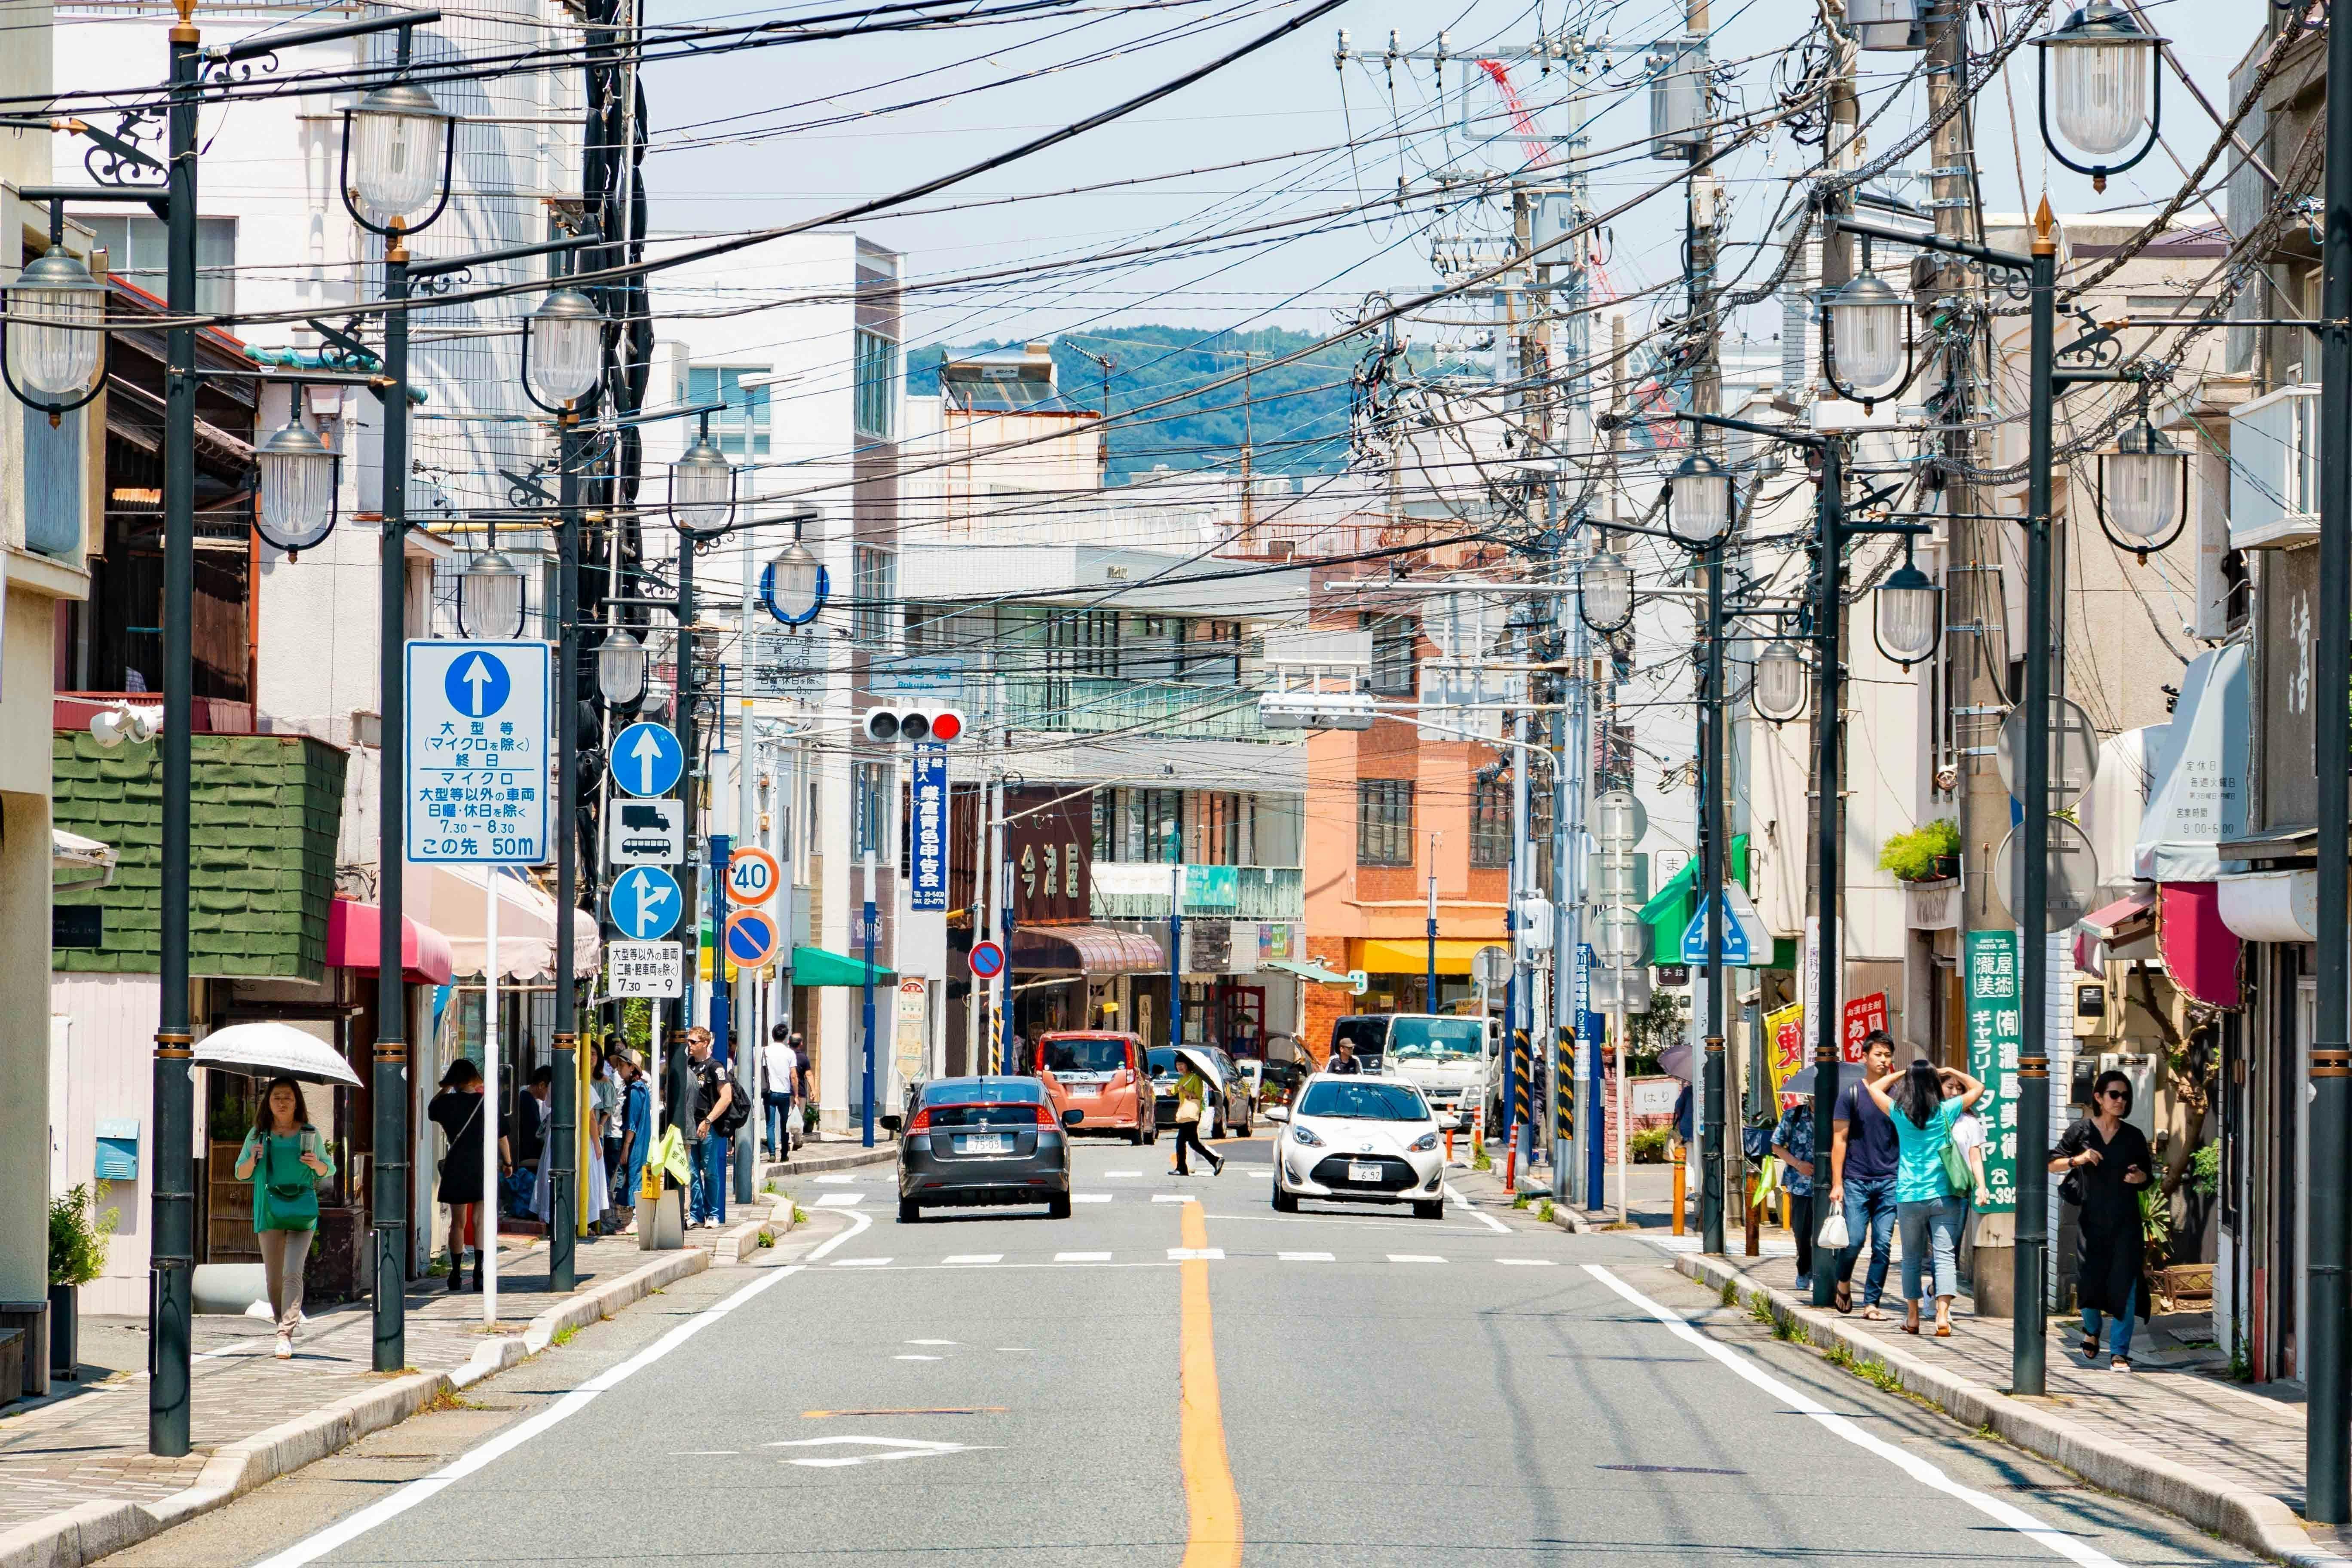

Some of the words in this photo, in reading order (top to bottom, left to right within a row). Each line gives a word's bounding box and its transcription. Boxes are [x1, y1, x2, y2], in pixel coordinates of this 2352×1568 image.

[441, 721, 514, 735] 大型等
[425, 736, 530, 752] (マイクロを除く)
[456, 753, 498, 767] 終日
[2187, 761, 2216, 771] 定休日
[441, 772, 513, 785] マイクロ
[2191, 777, 2235, 787] 毎週火曜日
[420, 788, 535, 801] 大型等以外の車両
[429, 803, 526, 817] 日曜・休日を除く
[2176, 808, 2208, 818] 営業時間
[919, 785, 940, 888] 鎌倉青色申告会
[423, 838, 478, 855] この先
[493, 838, 533, 855] 50m
[734, 863, 766, 889] 40
[613, 948, 678, 961] 大型等以外の車両
[1976, 975, 2012, 995] 美術
[1644, 1091, 1669, 1103] はり
